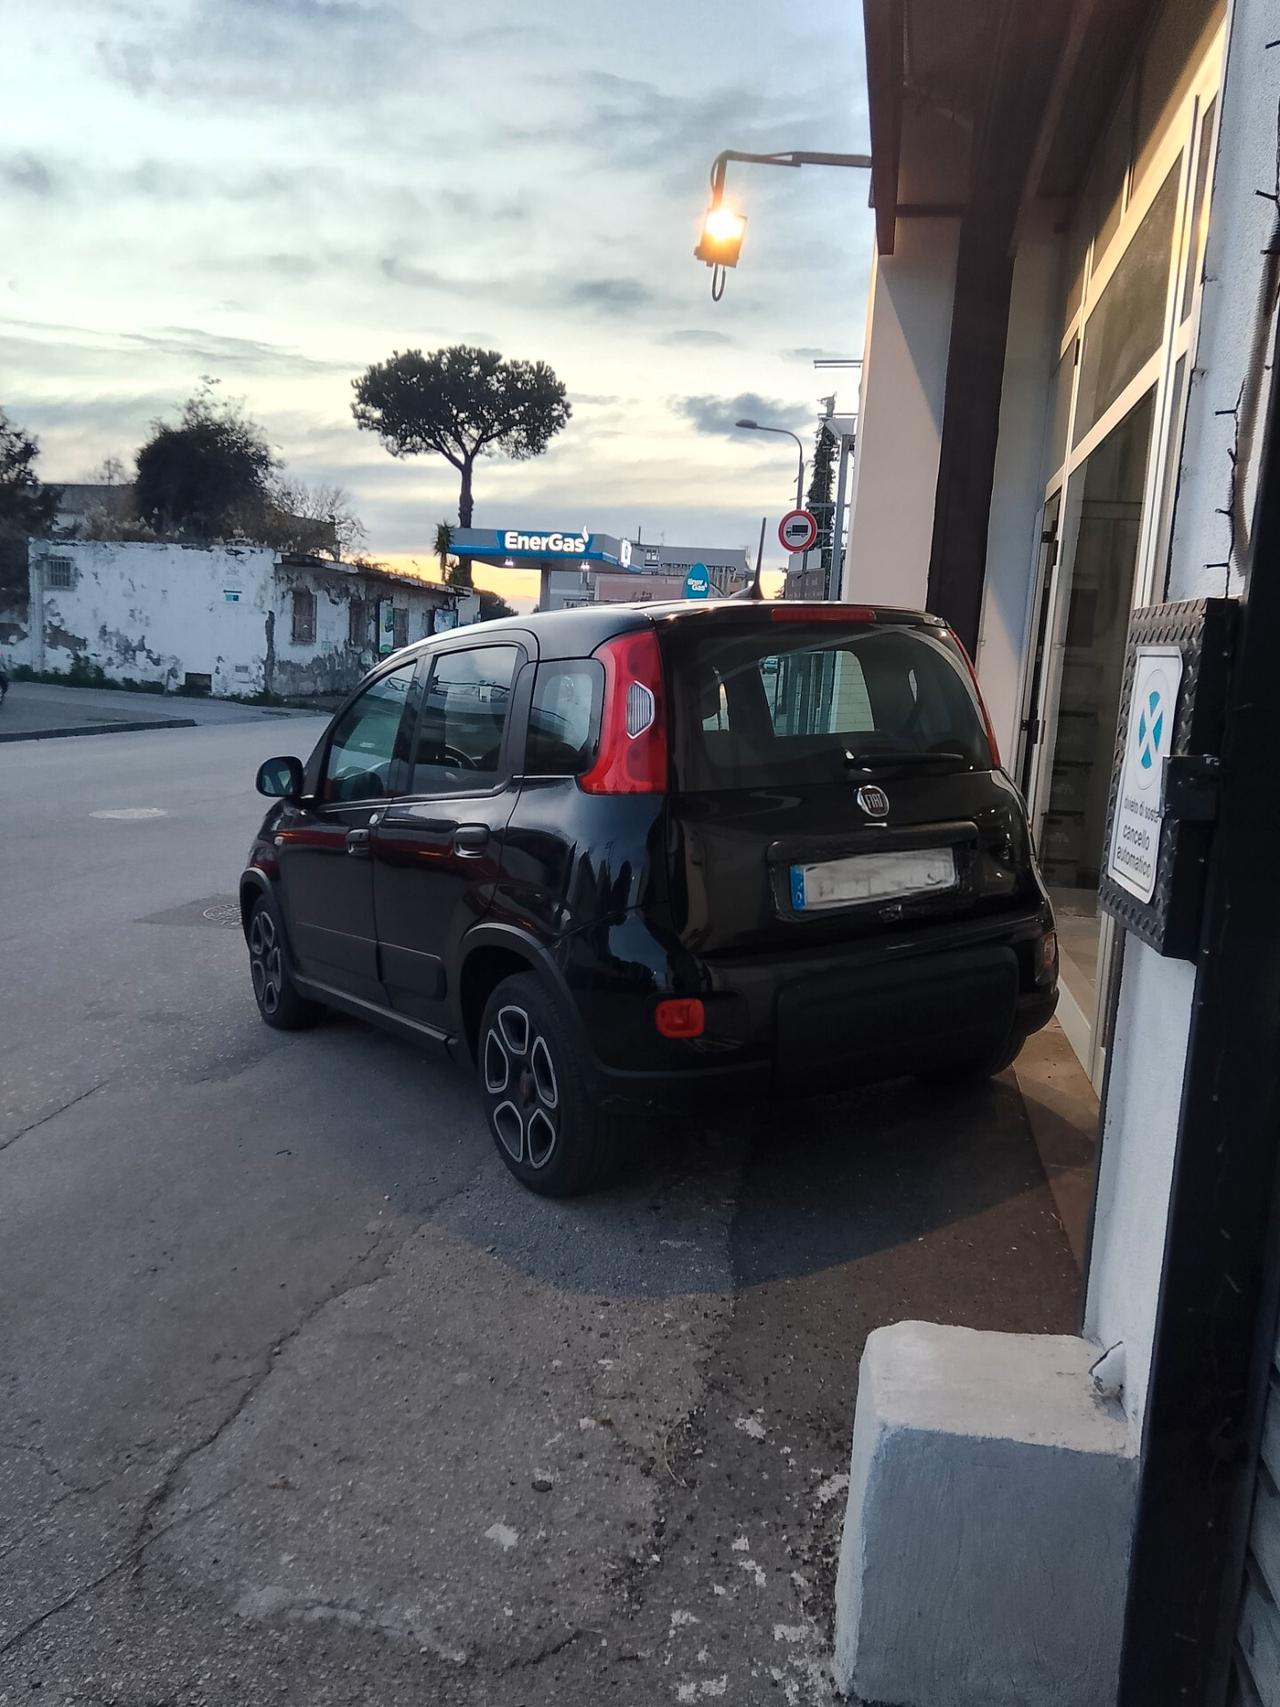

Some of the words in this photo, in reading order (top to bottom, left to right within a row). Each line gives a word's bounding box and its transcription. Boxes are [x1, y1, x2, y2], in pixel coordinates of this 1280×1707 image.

[504, 531, 586, 553] EnerGas
[864, 793, 884, 809] FIAT
[1123, 824, 1149, 851] cancello
[1117, 846, 1151, 879] automatico
